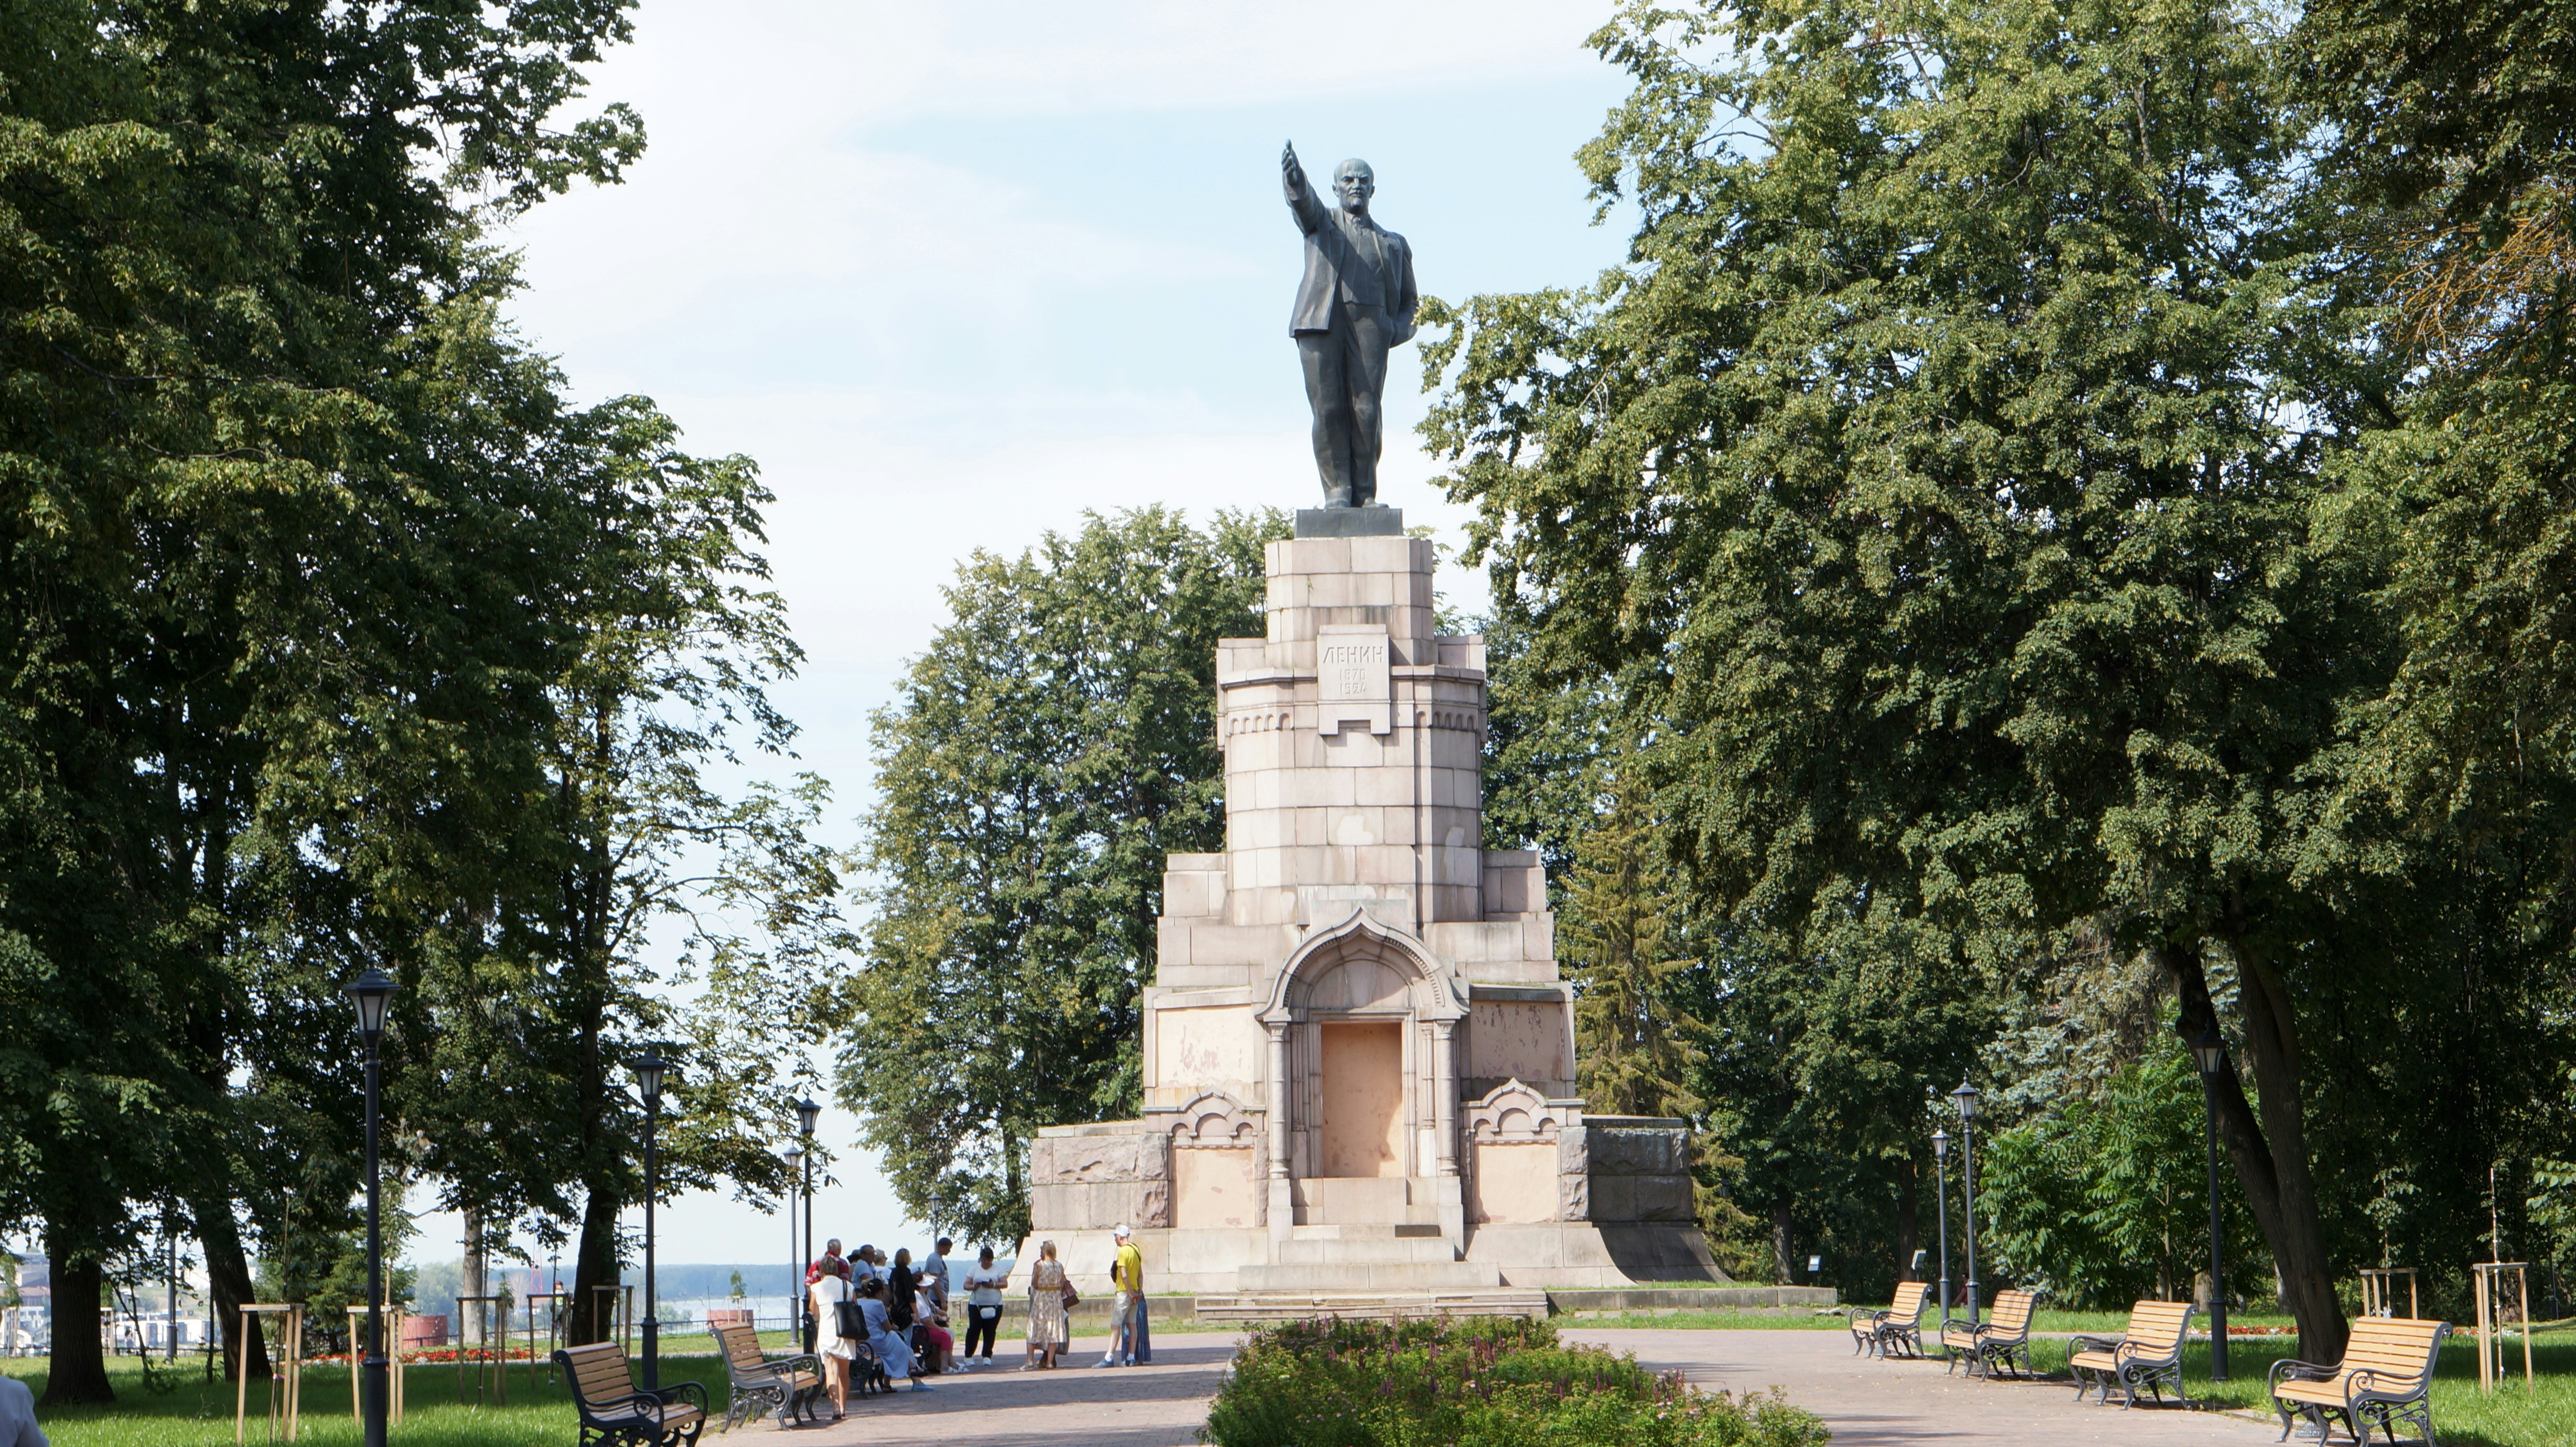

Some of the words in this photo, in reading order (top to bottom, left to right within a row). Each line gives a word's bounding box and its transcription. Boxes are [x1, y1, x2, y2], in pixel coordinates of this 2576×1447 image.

[1324, 646, 1383, 663] ЛЕНИН
[1340, 669, 1366, 681] 1870
[1340, 683, 1366, 695] 1924
